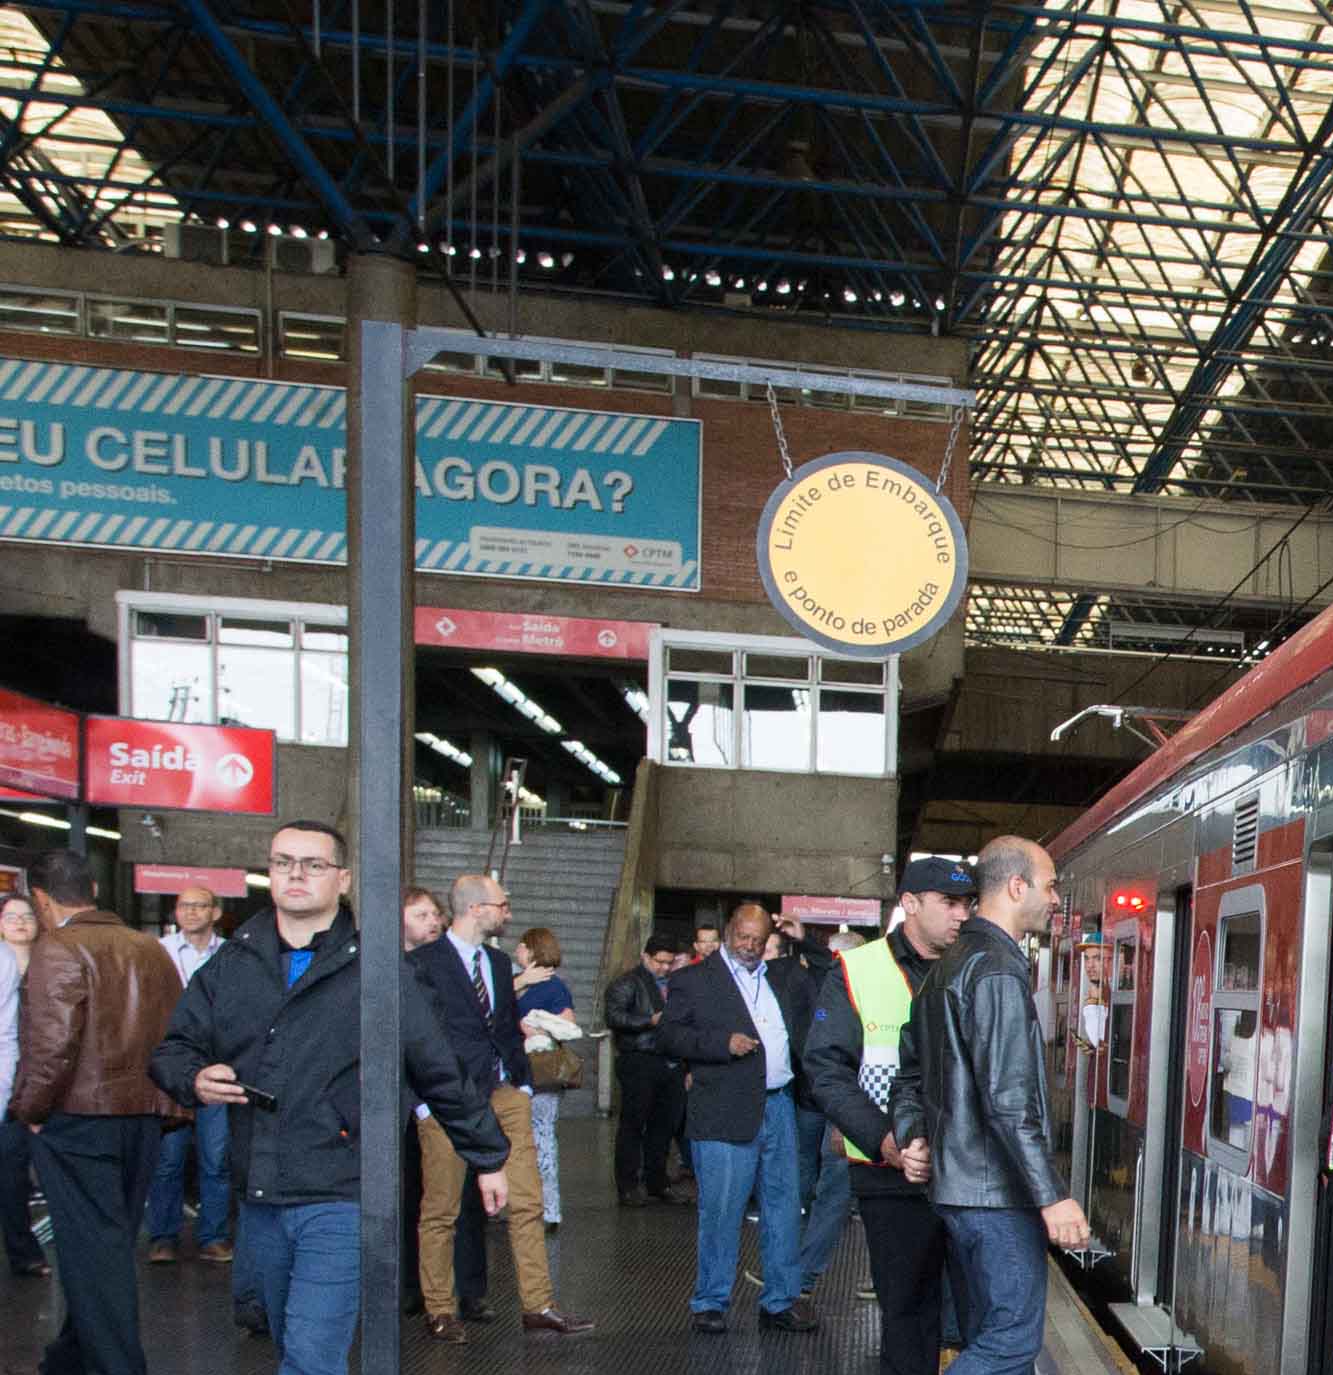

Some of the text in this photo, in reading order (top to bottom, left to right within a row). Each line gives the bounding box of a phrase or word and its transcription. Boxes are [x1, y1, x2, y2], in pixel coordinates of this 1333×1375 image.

[60, 479, 178, 505] pessoais.
[775, 471, 950, 564] Limite de Embarque
[784, 570, 939, 637] e ponto de parada
[109, 742, 203, 771] Saída
[110, 770, 146, 786] Exit
